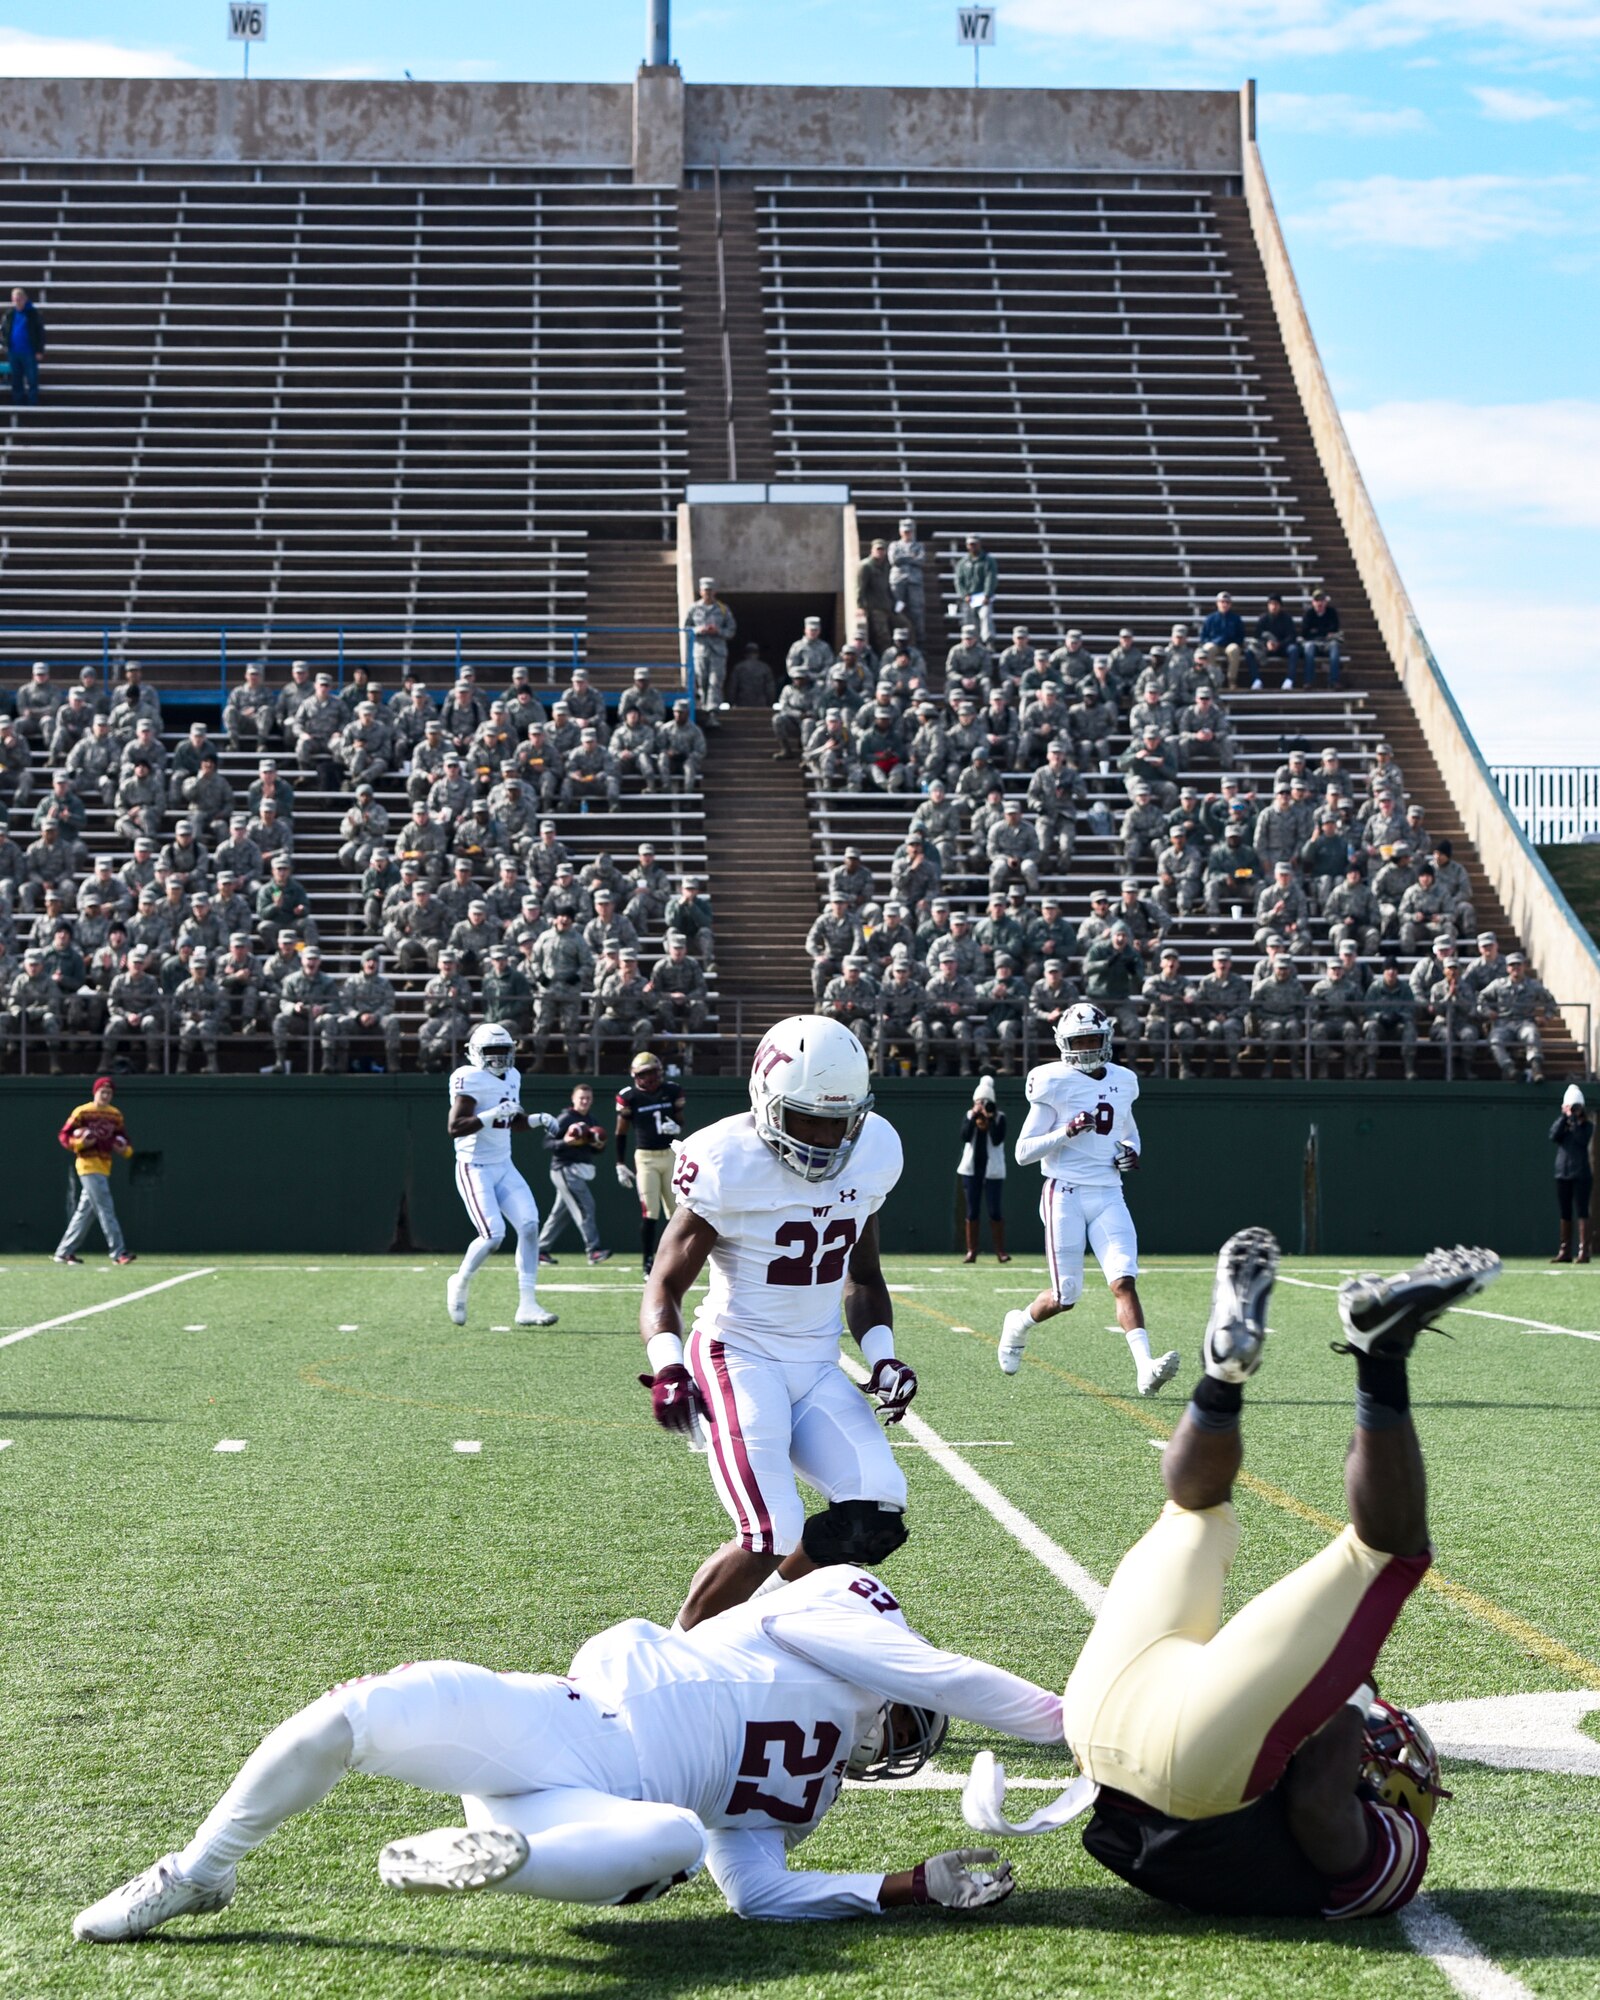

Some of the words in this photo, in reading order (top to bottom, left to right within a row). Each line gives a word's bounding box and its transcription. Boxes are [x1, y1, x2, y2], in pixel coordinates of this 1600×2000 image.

[231, 9, 262, 35] W6
[960, 14, 990, 39] W7
[812, 1205, 832, 1217] WT
[766, 1218, 857, 1286] 22
[848, 1577, 899, 1614] 27
[725, 1720, 842, 1823] 27
